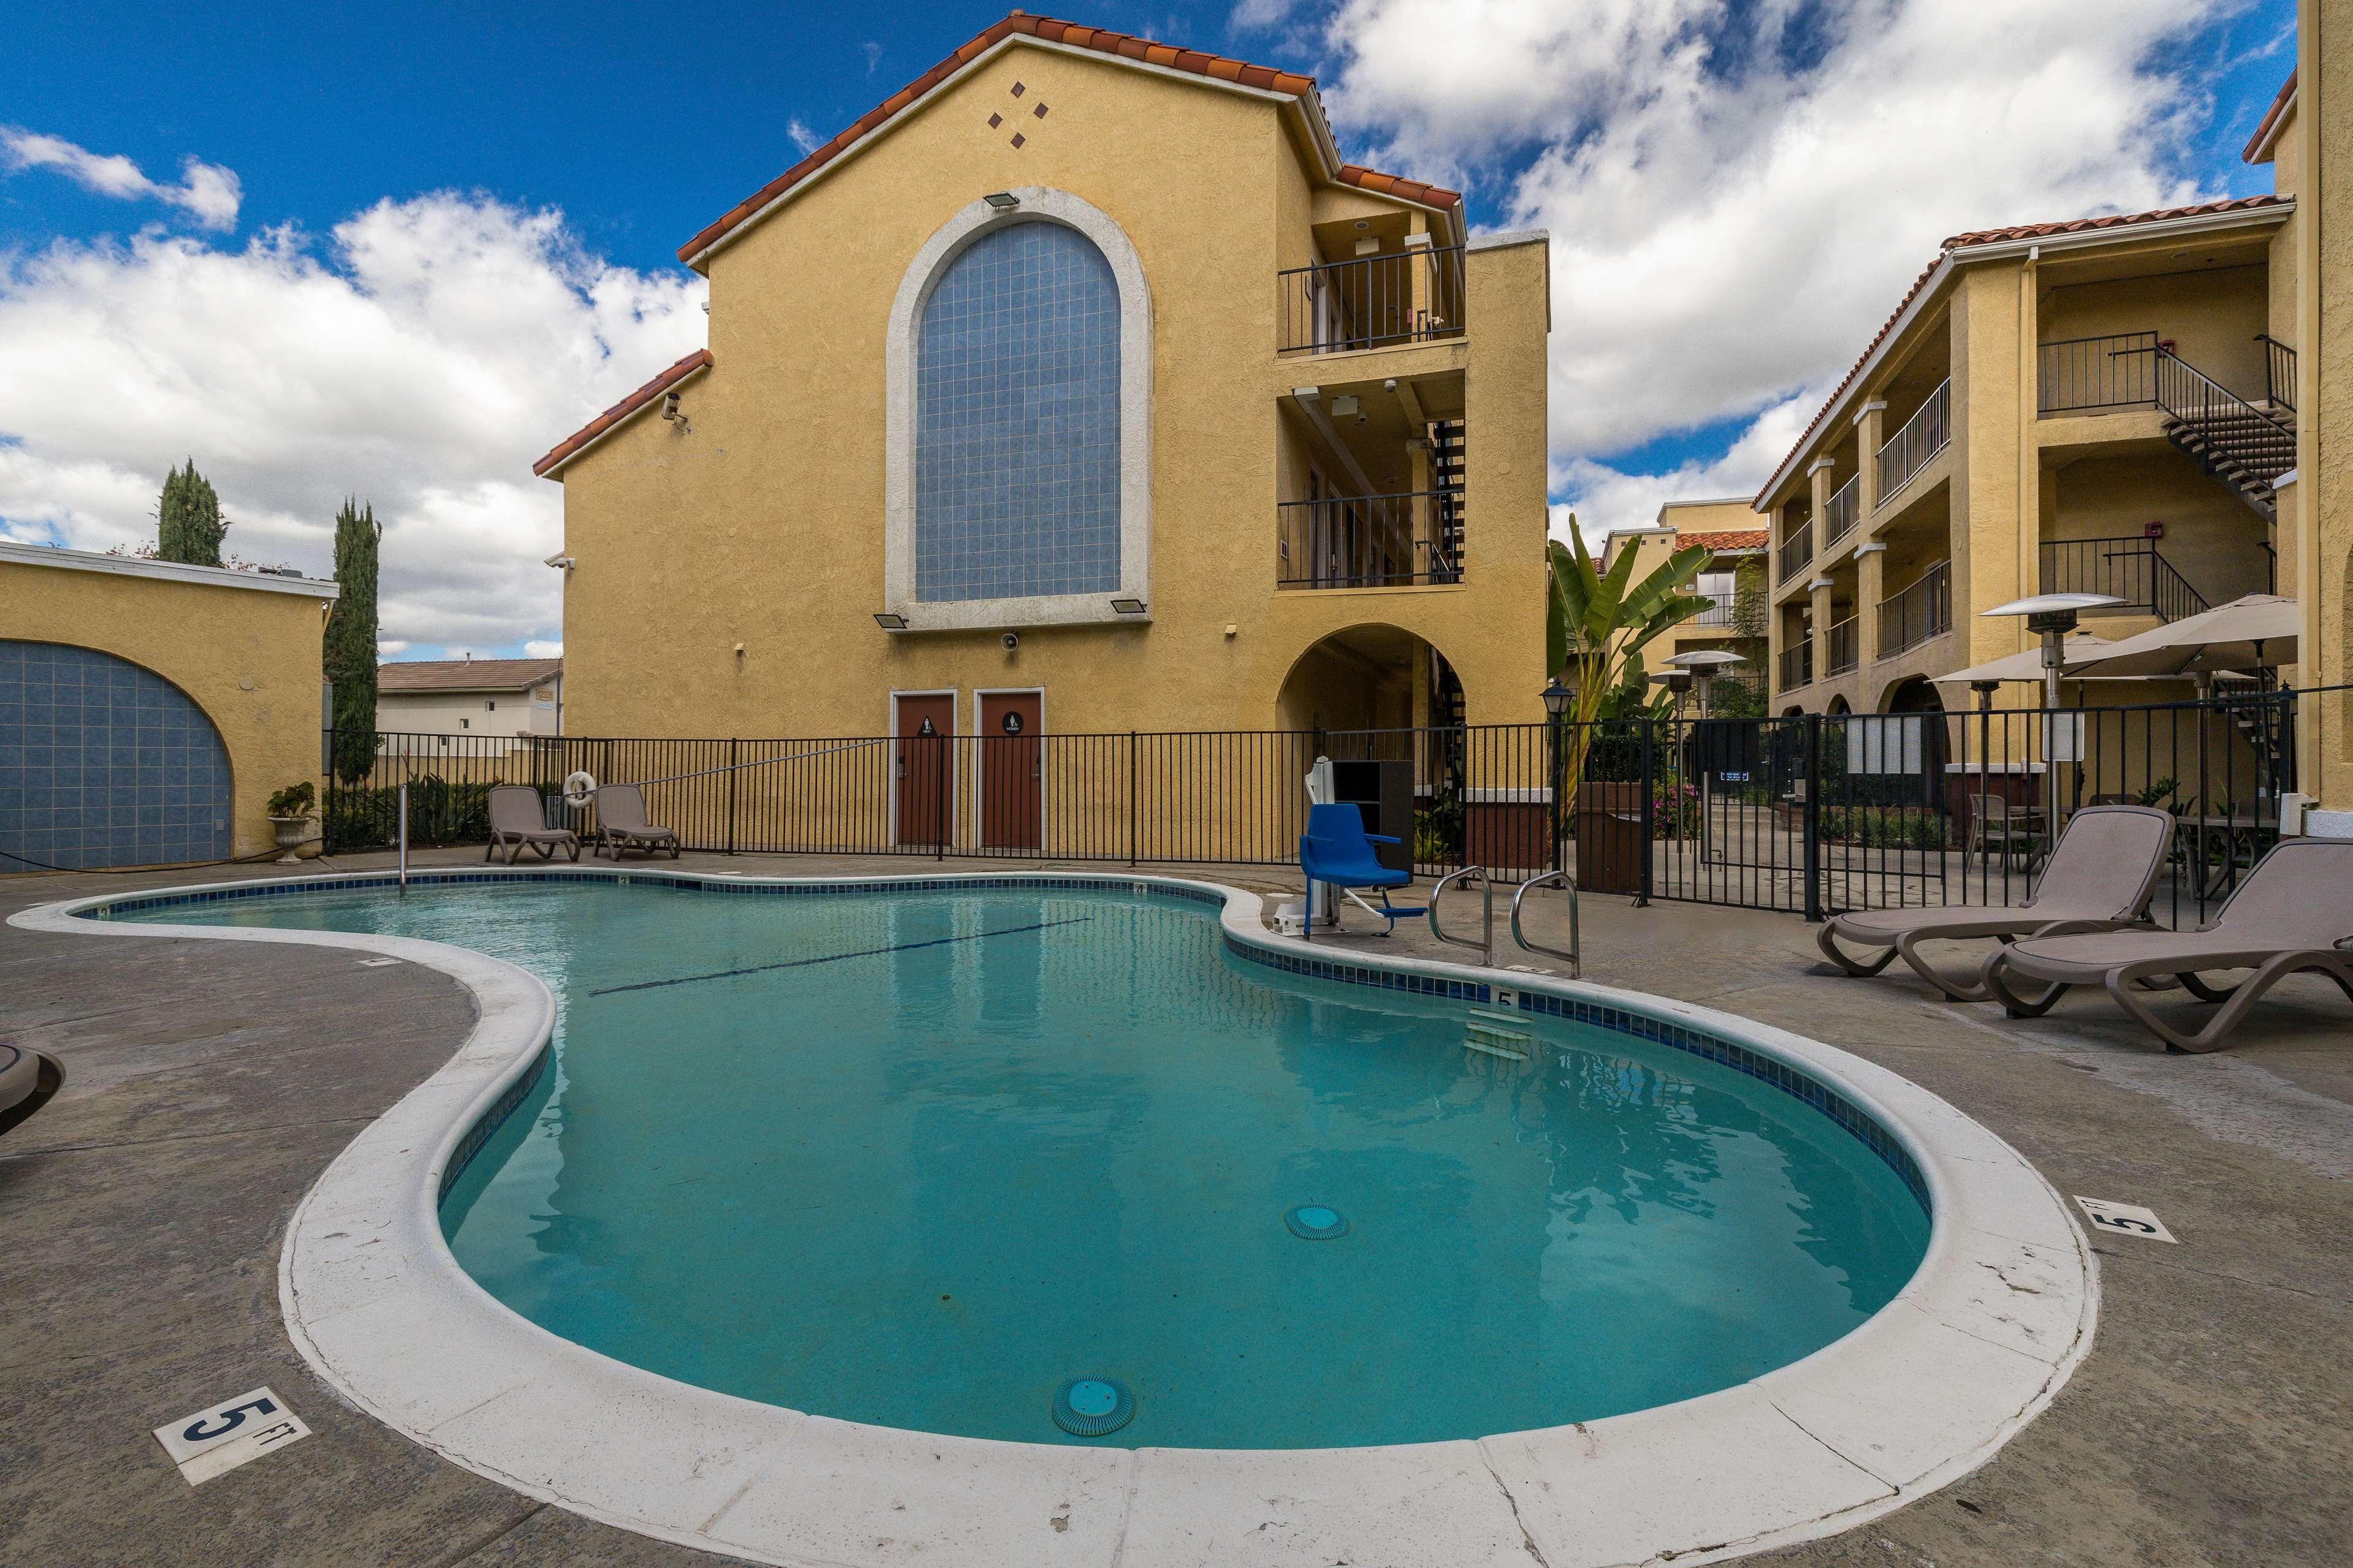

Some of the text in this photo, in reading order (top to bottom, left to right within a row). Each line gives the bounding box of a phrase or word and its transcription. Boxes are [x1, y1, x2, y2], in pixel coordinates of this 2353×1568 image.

[1497, 991, 1511, 1006] 5
[2091, 1213, 2157, 1233] 5
[183, 1397, 297, 1446] 5 FT
